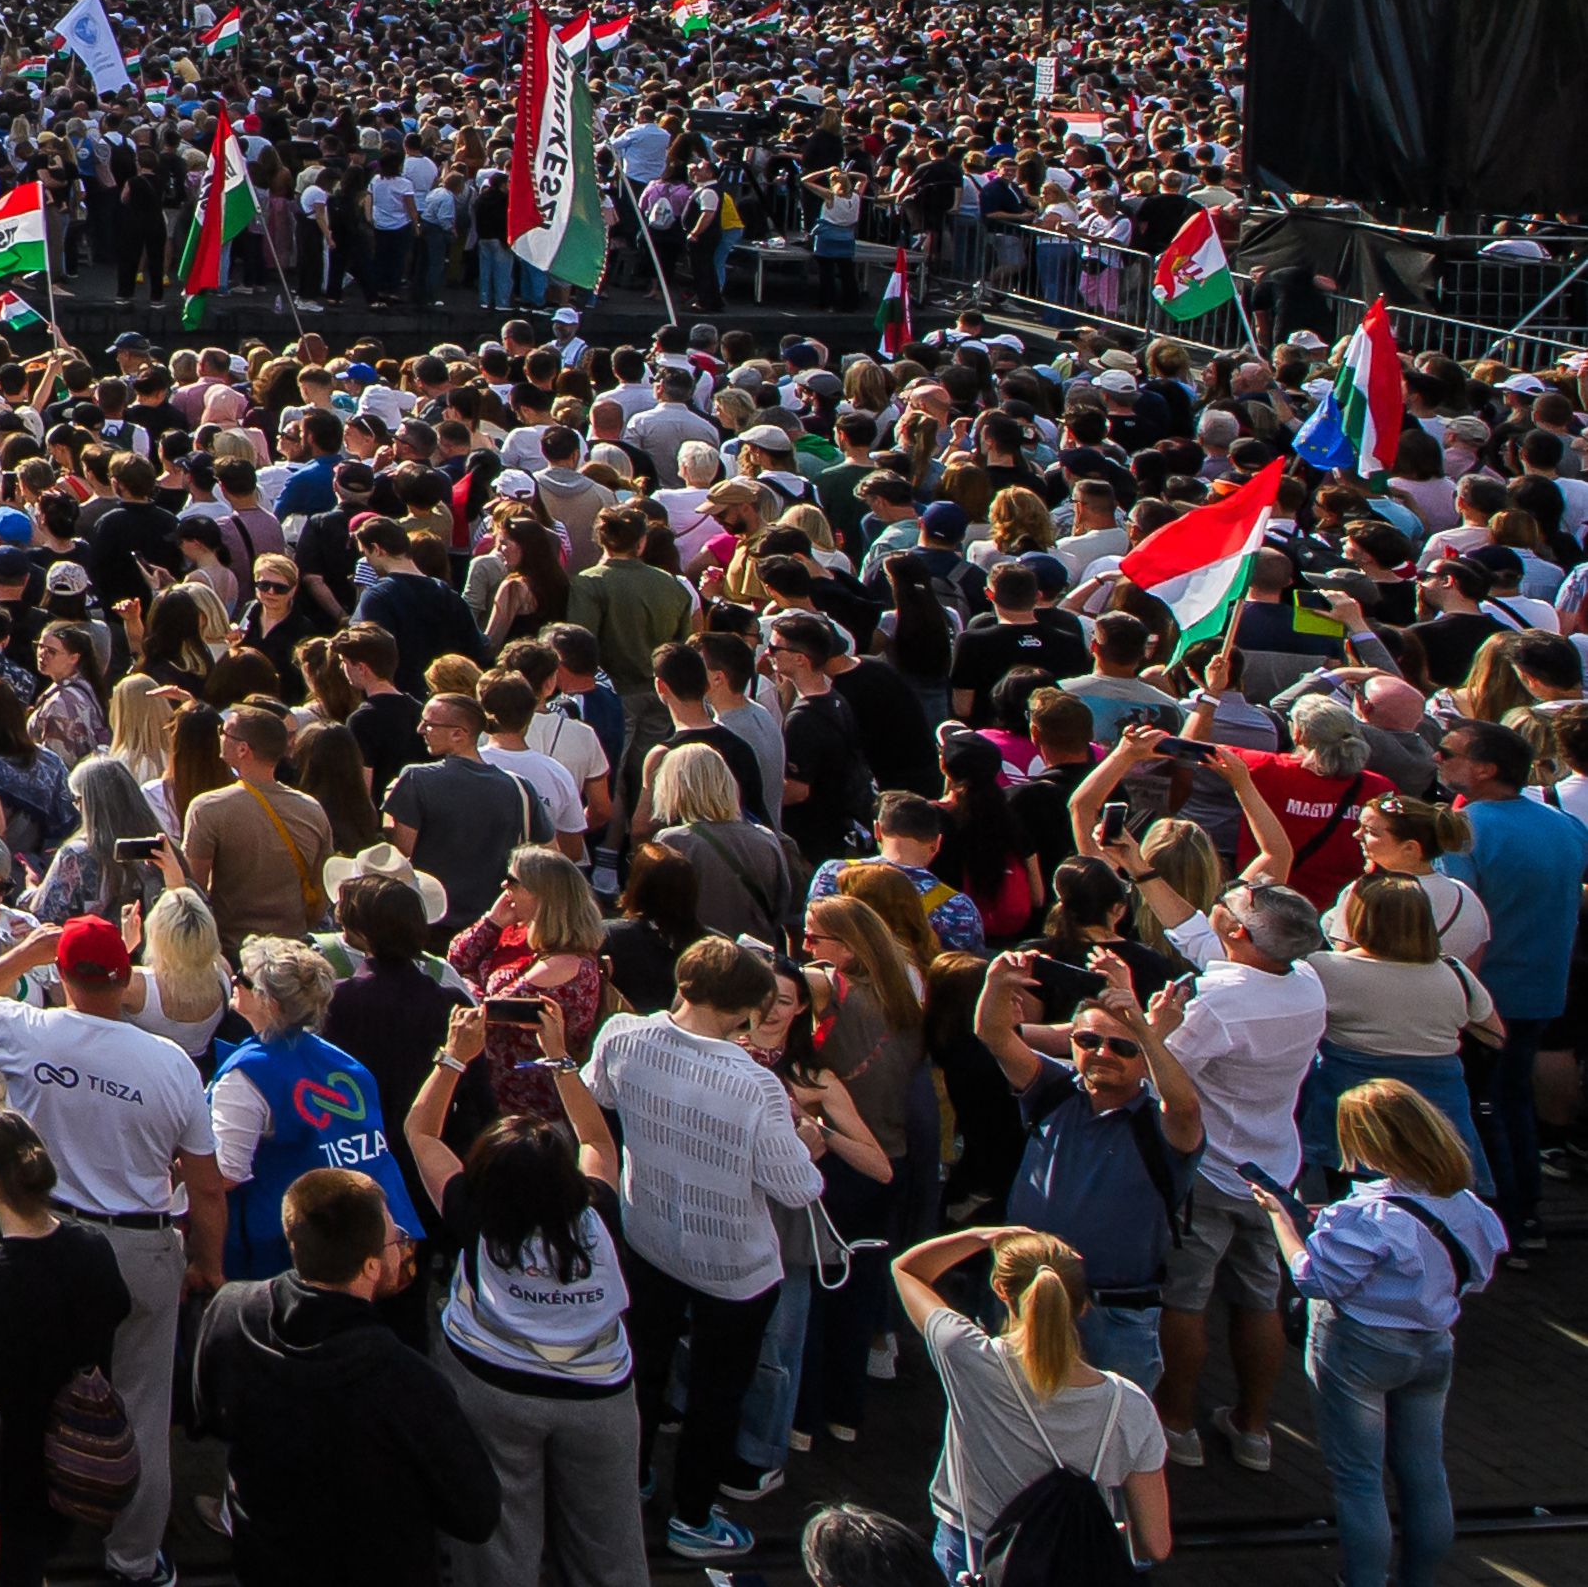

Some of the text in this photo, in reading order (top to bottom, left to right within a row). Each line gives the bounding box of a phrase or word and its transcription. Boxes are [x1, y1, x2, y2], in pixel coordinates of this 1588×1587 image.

[87, 1074, 144, 1106] TISZA
[318, 1129, 389, 1169] TISZA
[508, 1282, 605, 1306] ÖNKÉNTES
